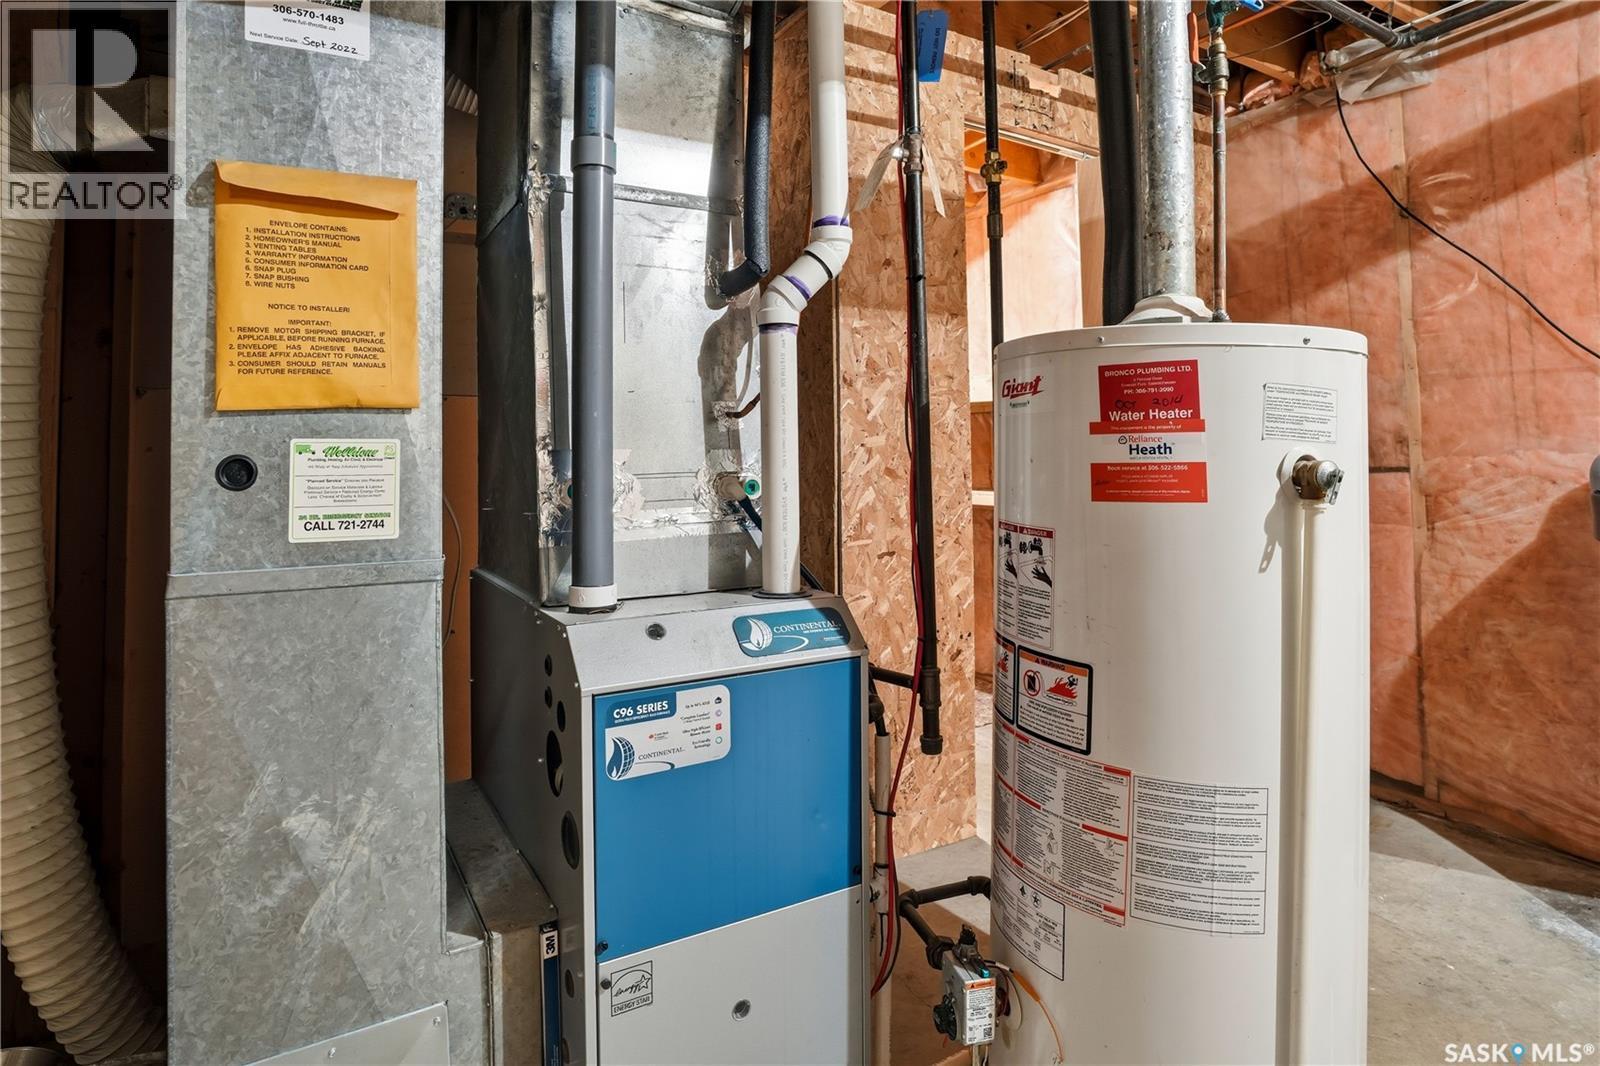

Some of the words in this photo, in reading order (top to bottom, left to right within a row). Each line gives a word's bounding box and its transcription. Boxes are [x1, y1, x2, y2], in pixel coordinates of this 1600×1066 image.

[273, 4, 344, 24] 306-570-1483
[302, 37, 326, 48] Sept
[330, 43, 358, 54] 2022
[270, 220, 308, 229] ENVELOPE
[254, 228, 307, 238] INSTALLATION
[309, 233, 360, 242] INSTRUCTIONS
[254, 235, 310, 245] HOMEOWNER'S
[254, 243, 286, 251] VENTING
[254, 250, 296, 259] WARRANTY
[254, 258, 296, 266] CONSUMER
[298, 262, 347, 270] INFORMATION
[1104, 369, 1135, 377] BRONCO
[1137, 366, 1176, 374] PLUMBING
[1002, 376, 1041, 398] Giant
[1109, 411, 1145, 421] Water
[1149, 409, 1193, 419] Heater
[1129, 443, 1172, 455] Heath
[304, 520, 335, 531] CALL
[338, 519, 384, 530] 721-2744
[774, 620, 838, 633] CONTINENTAL
[613, 706, 633, 719] C96
[636, 701, 668, 715] SERIES
[638, 747, 684, 760] CONTINENTAL
[545, 935, 555, 955] 3M
[614, 1001, 635, 1013] ENERGY
[636, 996, 650, 1006] STAR
